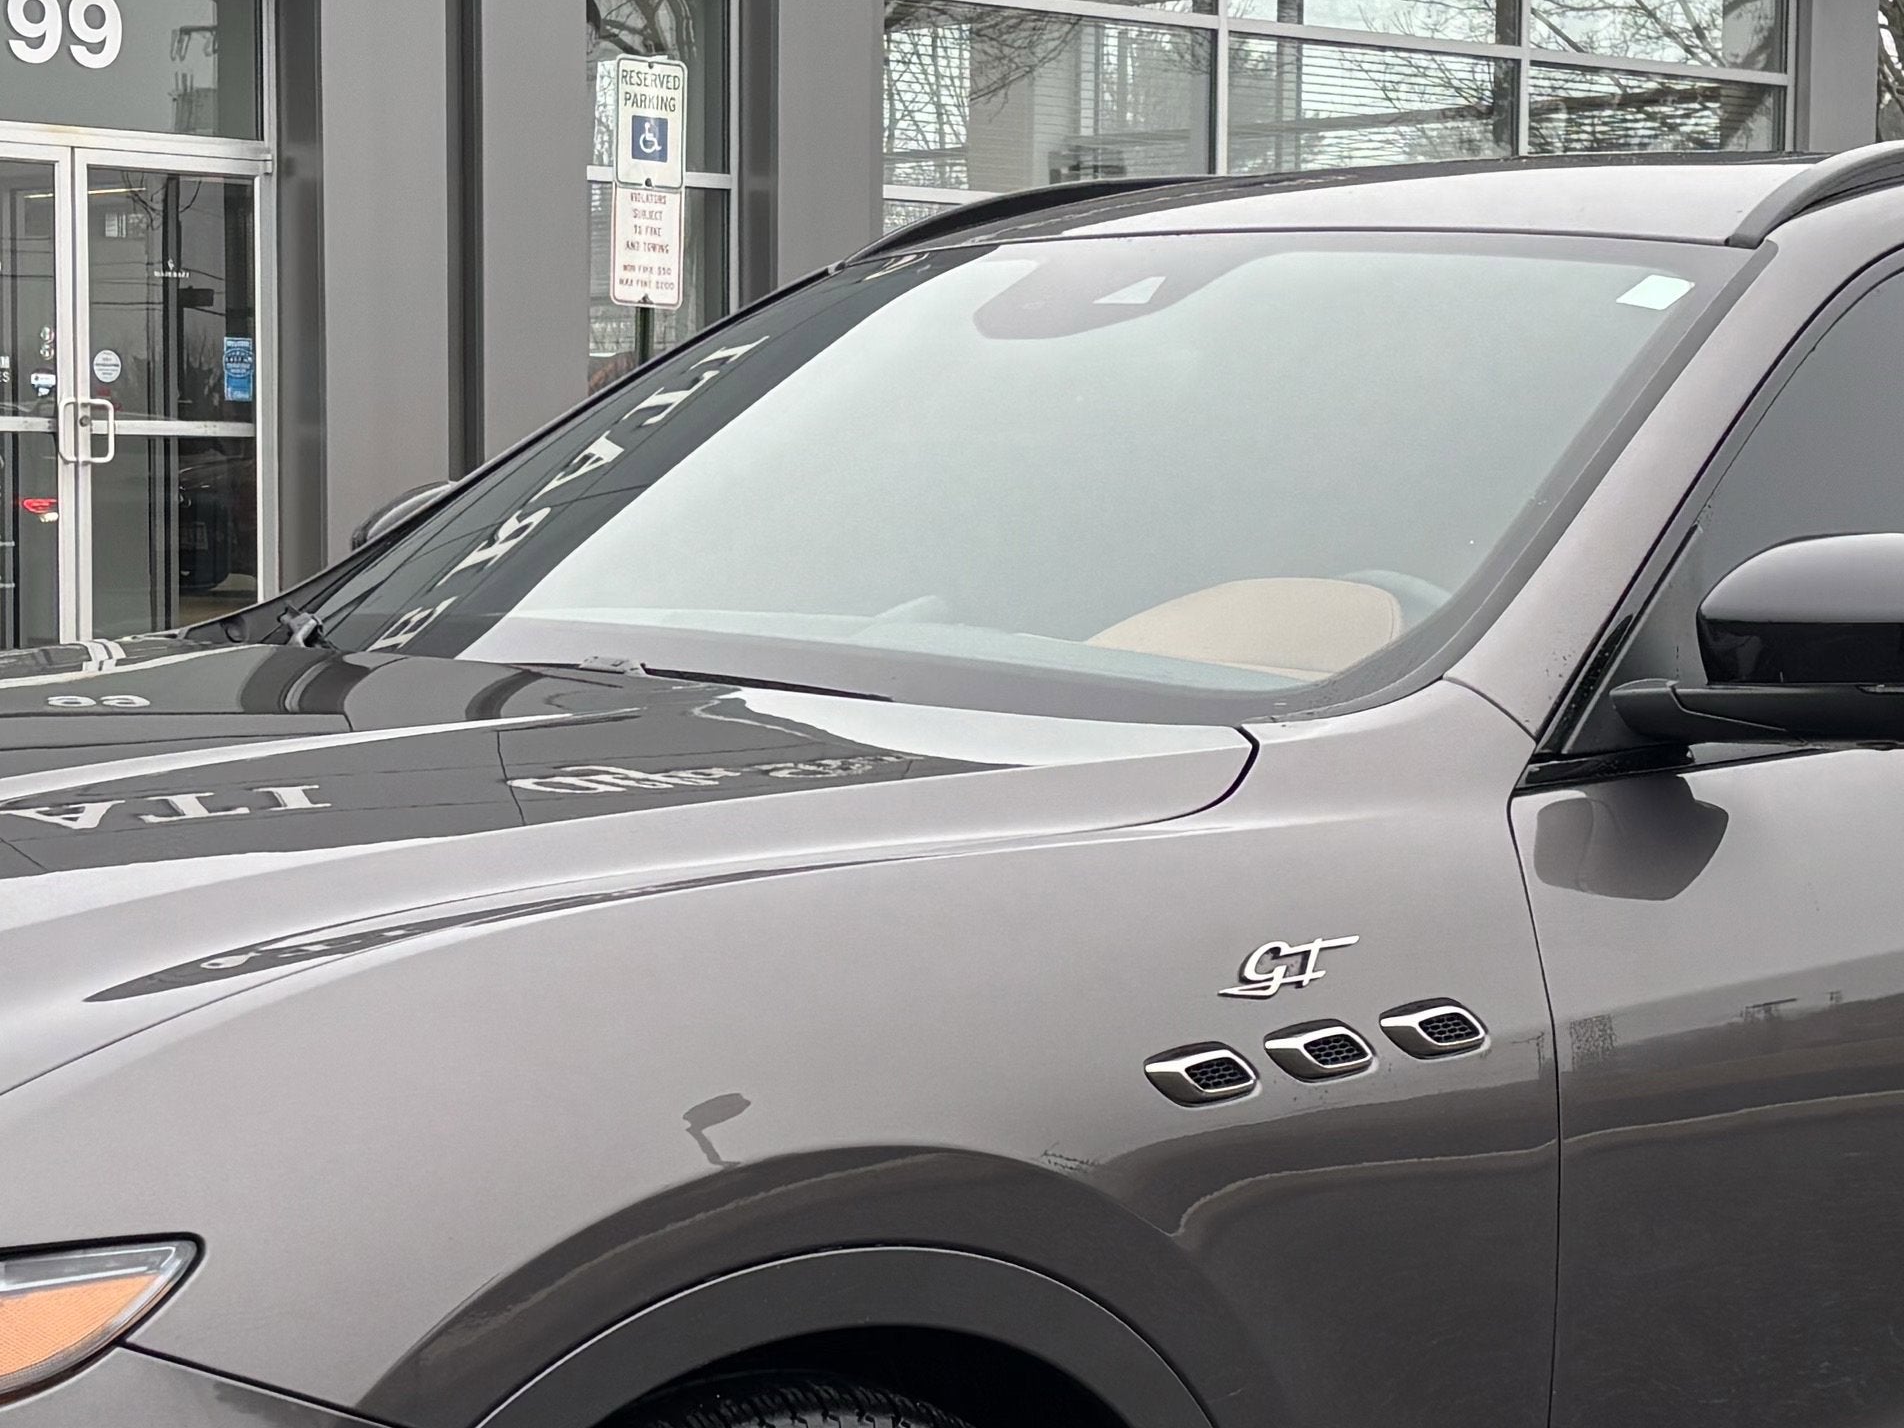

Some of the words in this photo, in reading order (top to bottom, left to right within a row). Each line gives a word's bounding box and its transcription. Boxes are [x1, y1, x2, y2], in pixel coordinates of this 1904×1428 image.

[621, 69, 681, 91] RESERVED
[624, 91, 676, 112] PARKING
[1217, 934, 1361, 1000] GT
